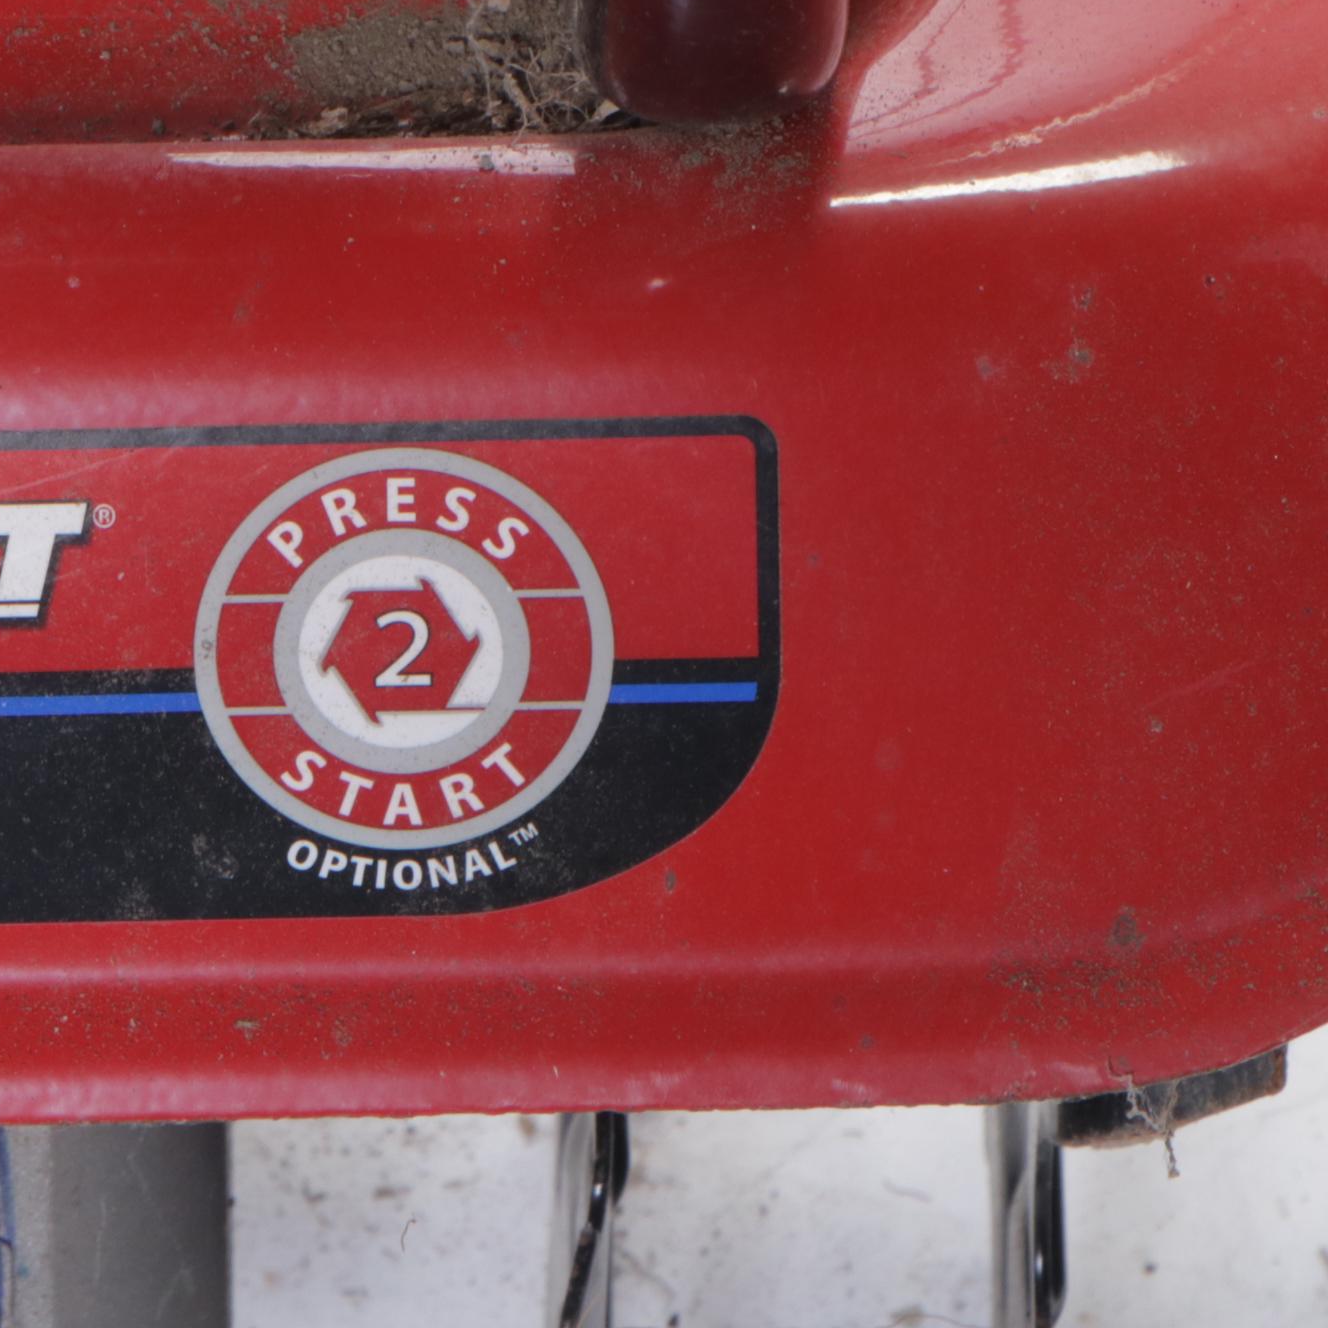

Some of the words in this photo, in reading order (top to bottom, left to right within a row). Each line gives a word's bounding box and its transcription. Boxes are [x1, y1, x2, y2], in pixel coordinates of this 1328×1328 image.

[267, 478, 529, 567] PRESS
[375, 611, 433, 687] 2
[281, 743, 527, 827] START
